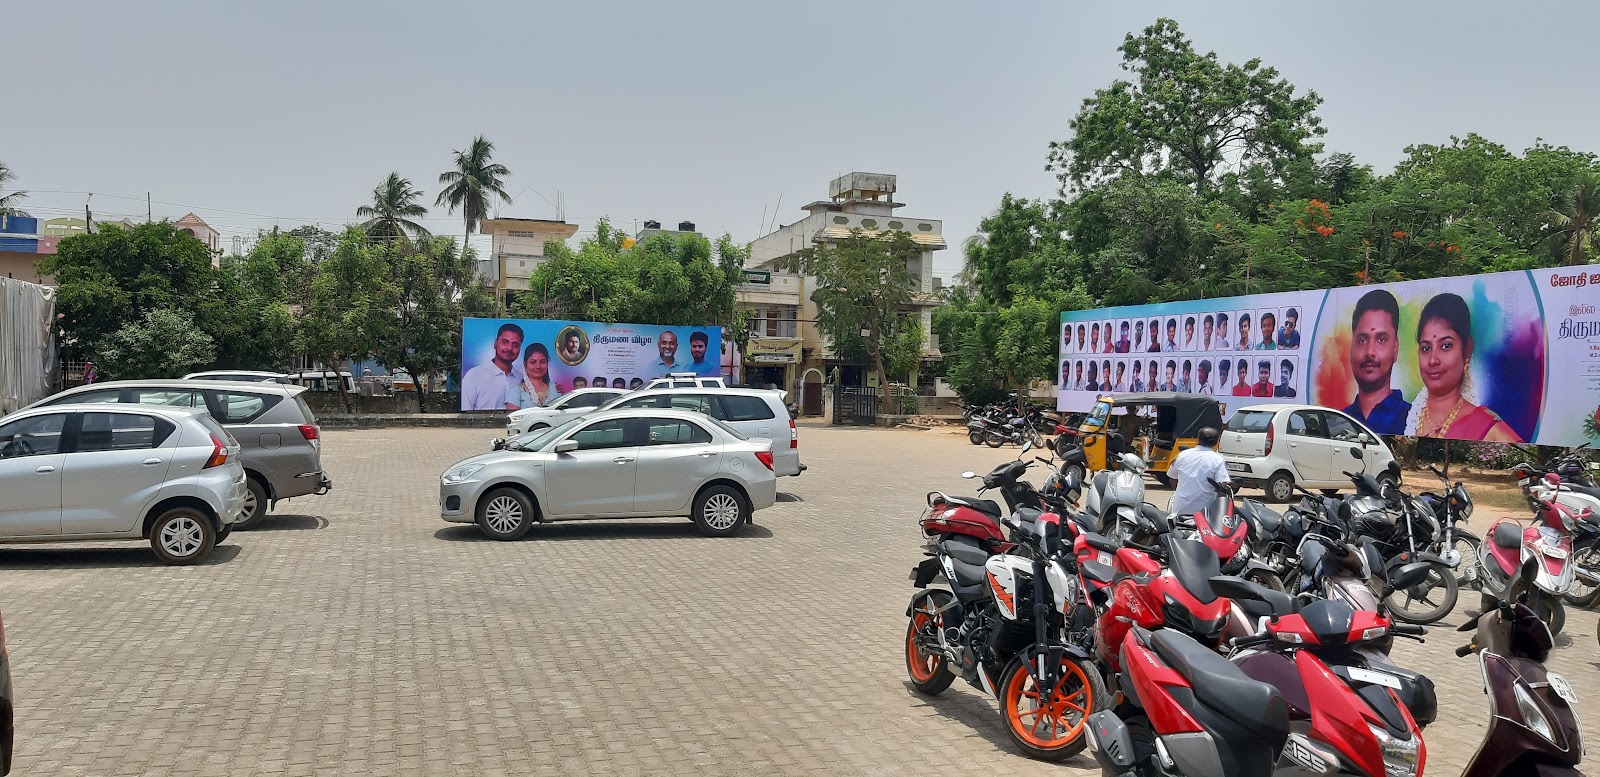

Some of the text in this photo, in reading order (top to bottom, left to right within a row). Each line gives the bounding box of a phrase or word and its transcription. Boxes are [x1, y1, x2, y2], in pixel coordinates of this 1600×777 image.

[1550, 271, 1587, 289] ஜோதி
[592, 333, 653, 346] திருமண விழா
[1292, 741, 1328, 774] 125
